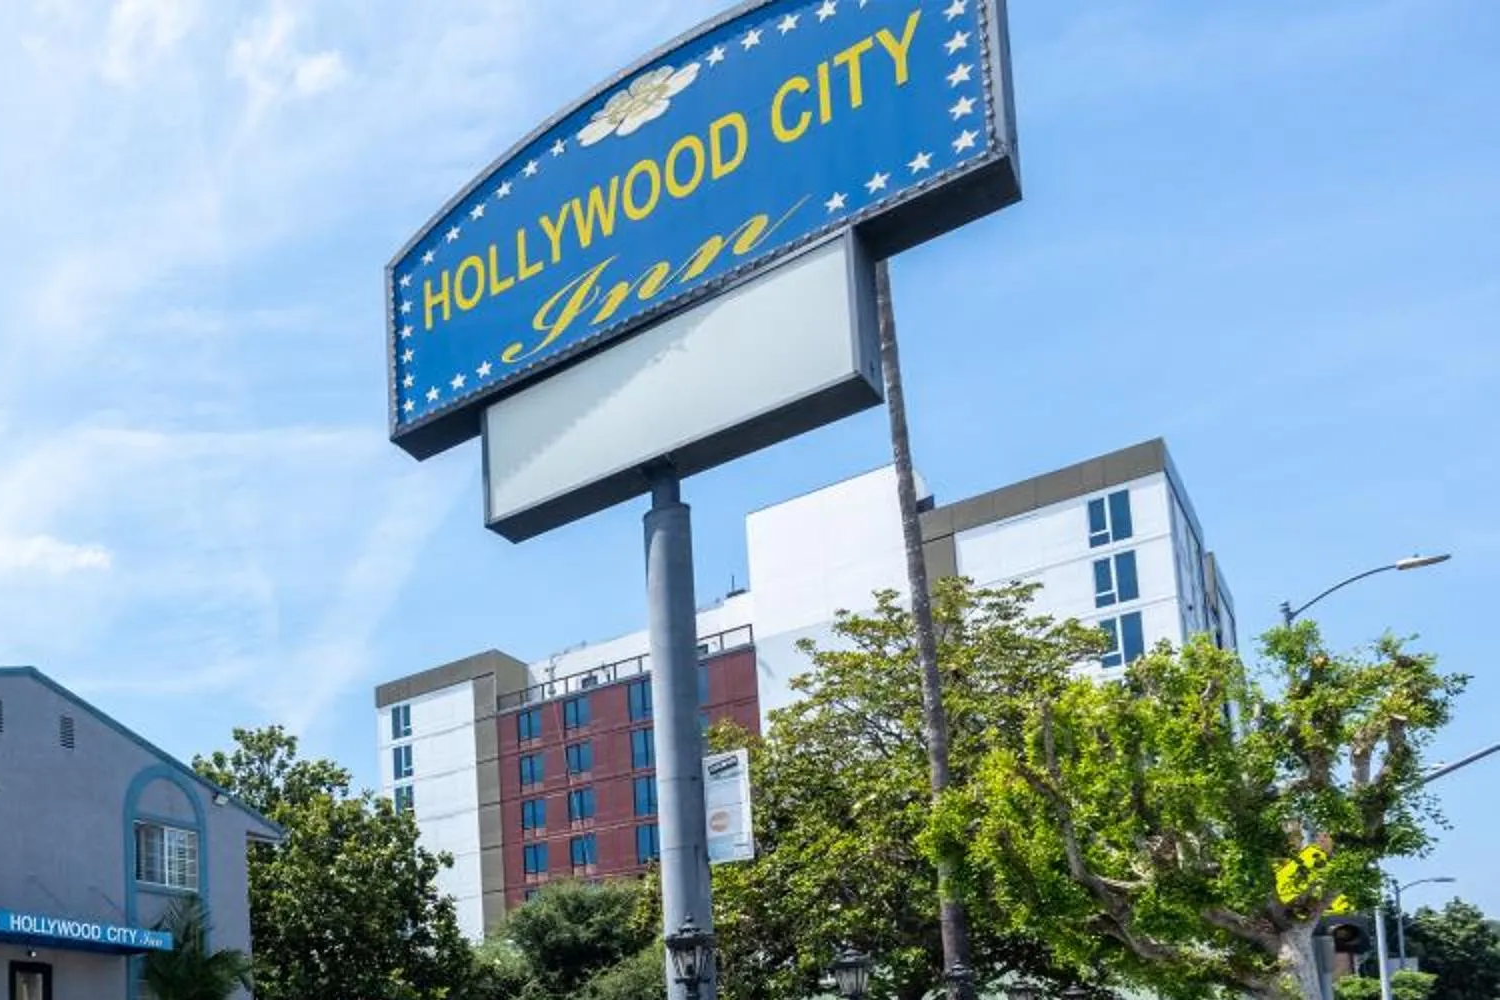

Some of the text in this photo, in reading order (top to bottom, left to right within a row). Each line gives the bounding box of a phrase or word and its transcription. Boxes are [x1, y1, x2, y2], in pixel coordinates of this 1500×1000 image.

[422, 10, 922, 331] HOLLYWOOD CITY
[501, 194, 812, 364] Inn
[10, 914, 101, 940] HOLLYWOOD
[107, 926, 138, 945] CITY
